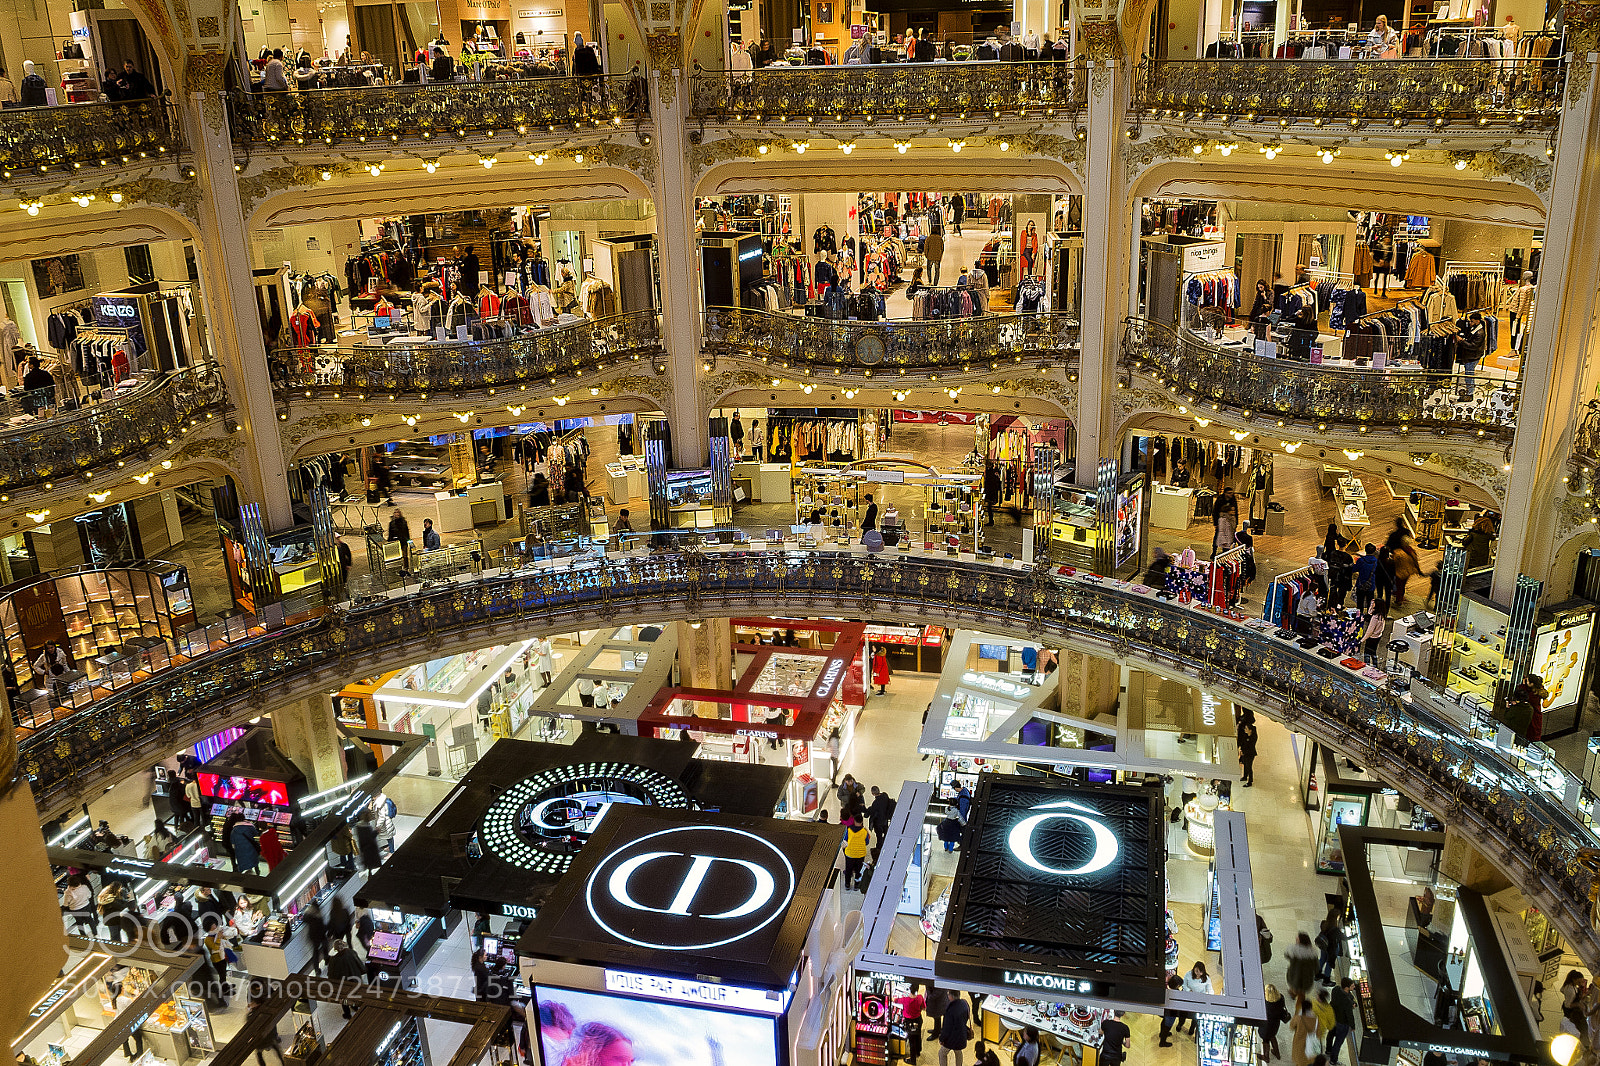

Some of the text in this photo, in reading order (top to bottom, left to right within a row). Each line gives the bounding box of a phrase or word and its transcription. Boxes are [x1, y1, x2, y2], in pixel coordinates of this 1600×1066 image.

[100, 304, 135, 317] KENZO
[1560, 613, 1589, 626] CHANEL
[816, 658, 844, 698] CLARINS
[736, 728, 778, 740] CLARINS
[502, 903, 537, 919] DIOR
